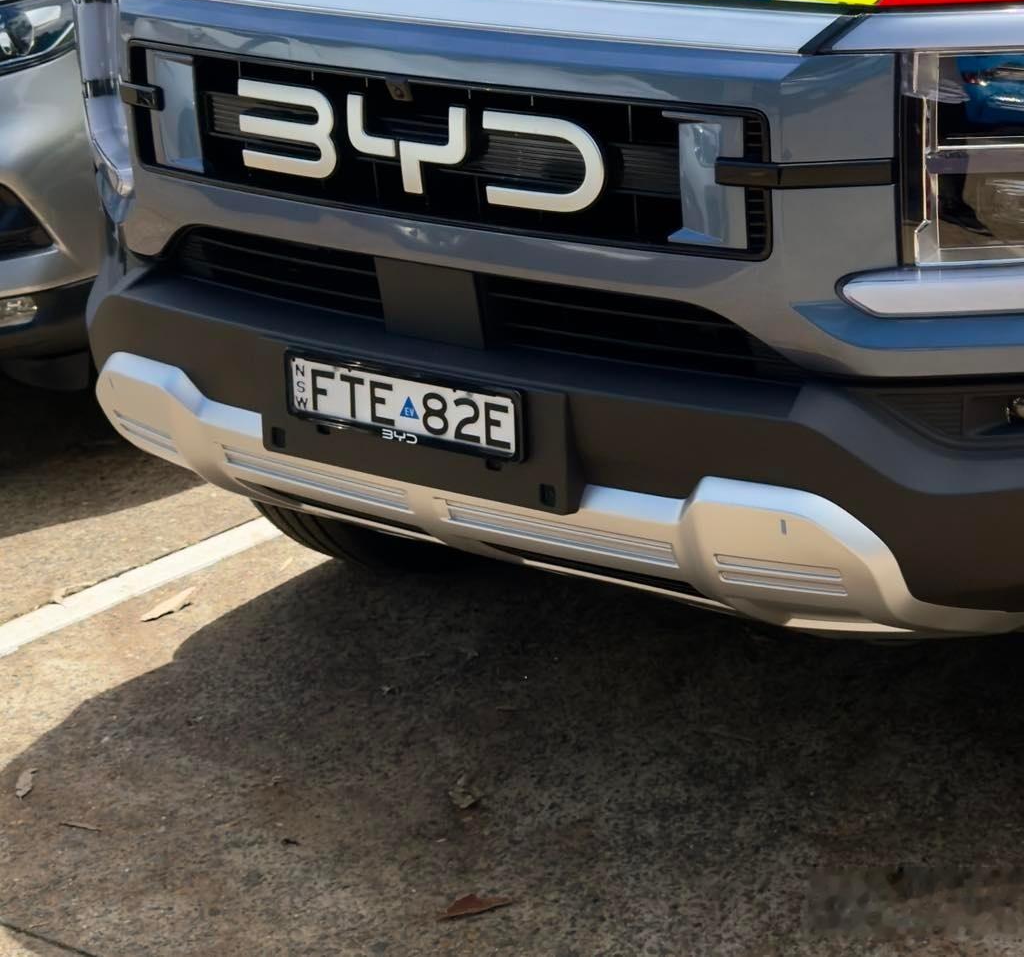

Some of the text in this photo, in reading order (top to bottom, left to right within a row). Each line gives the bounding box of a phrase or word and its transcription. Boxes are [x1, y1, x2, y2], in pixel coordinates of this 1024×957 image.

[237, 77, 606, 213] BYD
[295, 363, 309, 410] NSW
[311, 368, 512, 450] FTE EV 82E
[381, 428, 418, 445] BYD
